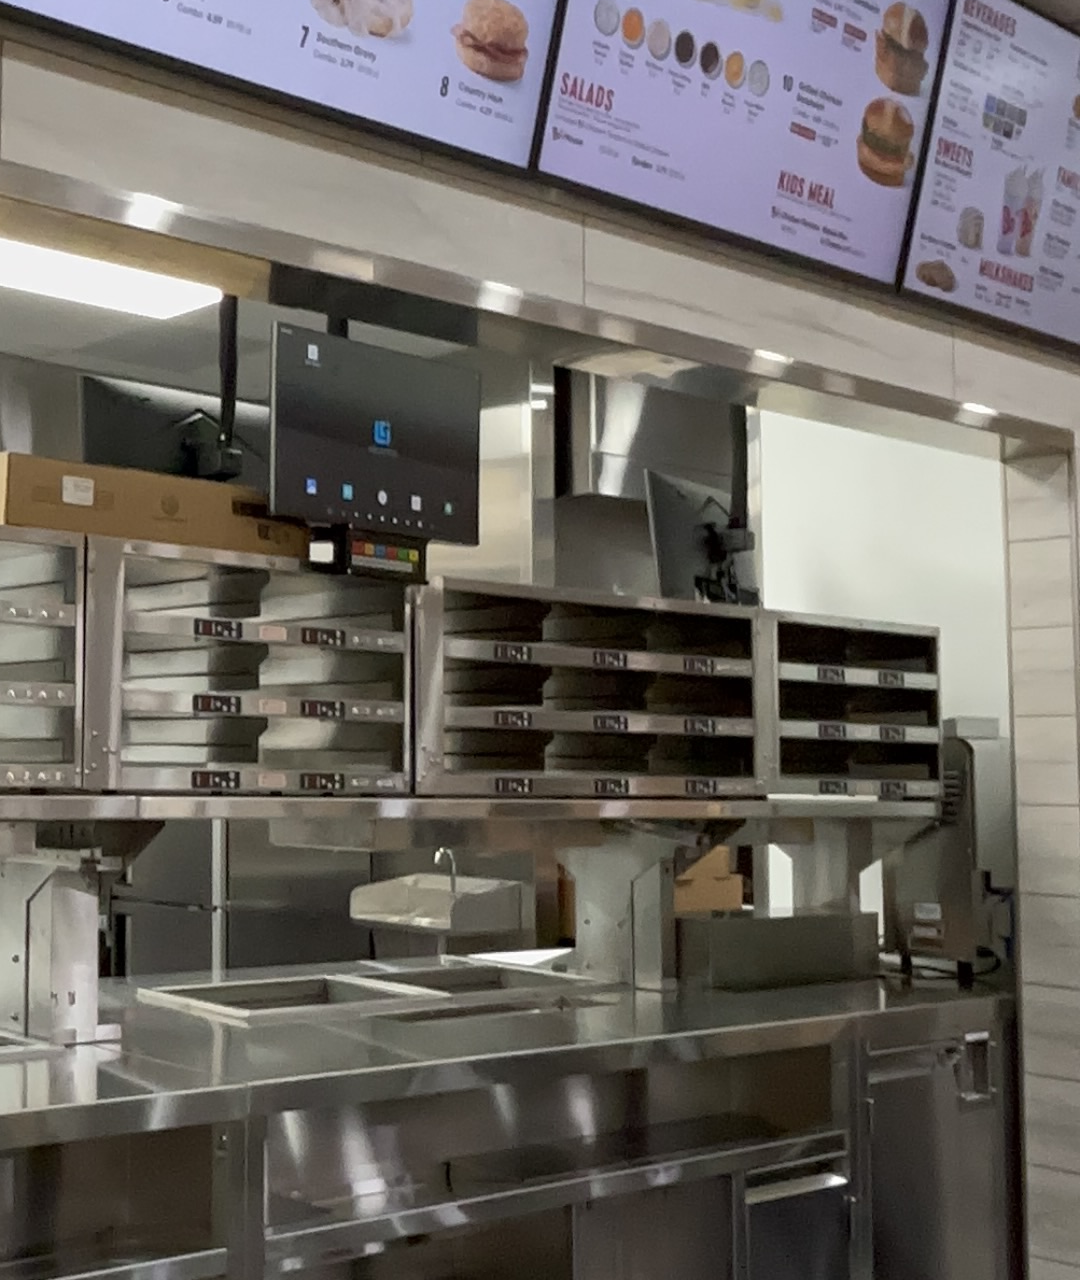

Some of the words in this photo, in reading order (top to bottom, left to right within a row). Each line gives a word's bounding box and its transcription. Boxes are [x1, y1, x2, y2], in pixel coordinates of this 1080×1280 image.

[298, 24, 310, 49] 7
[439, 74, 450, 99] 8
[559, 71, 616, 113] SALADS
[776, 169, 806, 202] KIDS
[807, 182, 836, 211] MEAL
